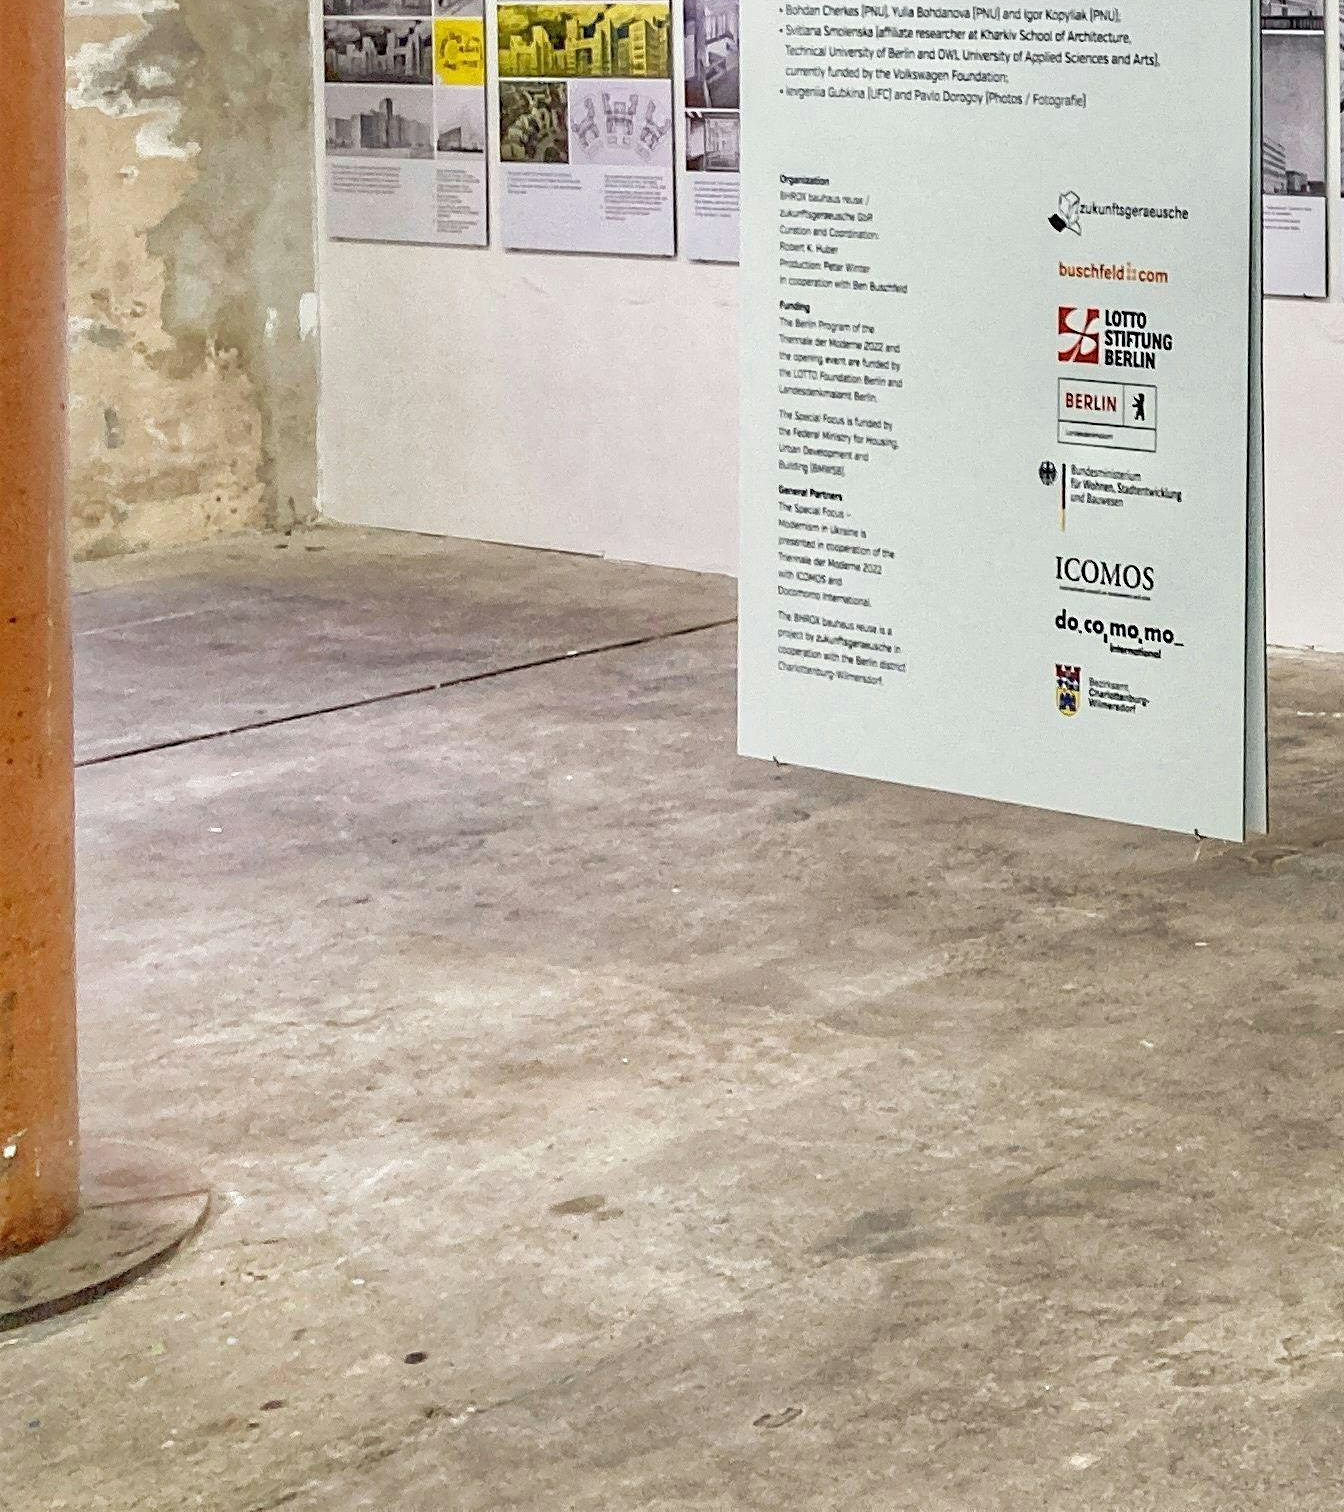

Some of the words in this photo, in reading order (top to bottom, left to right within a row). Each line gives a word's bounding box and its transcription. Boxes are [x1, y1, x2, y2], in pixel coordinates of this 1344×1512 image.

[1079, 201, 1188, 220] zukunftsgeraeusche
[780, 300, 810, 314] Funding
[1104, 308, 1148, 330] LOTTO
[1104, 330, 1173, 350] STIFTUNG
[1104, 350, 1156, 370] BERLIN
[1065, 392, 1117, 412] BERLIN
[1056, 556, 1154, 591] ICOMOS
